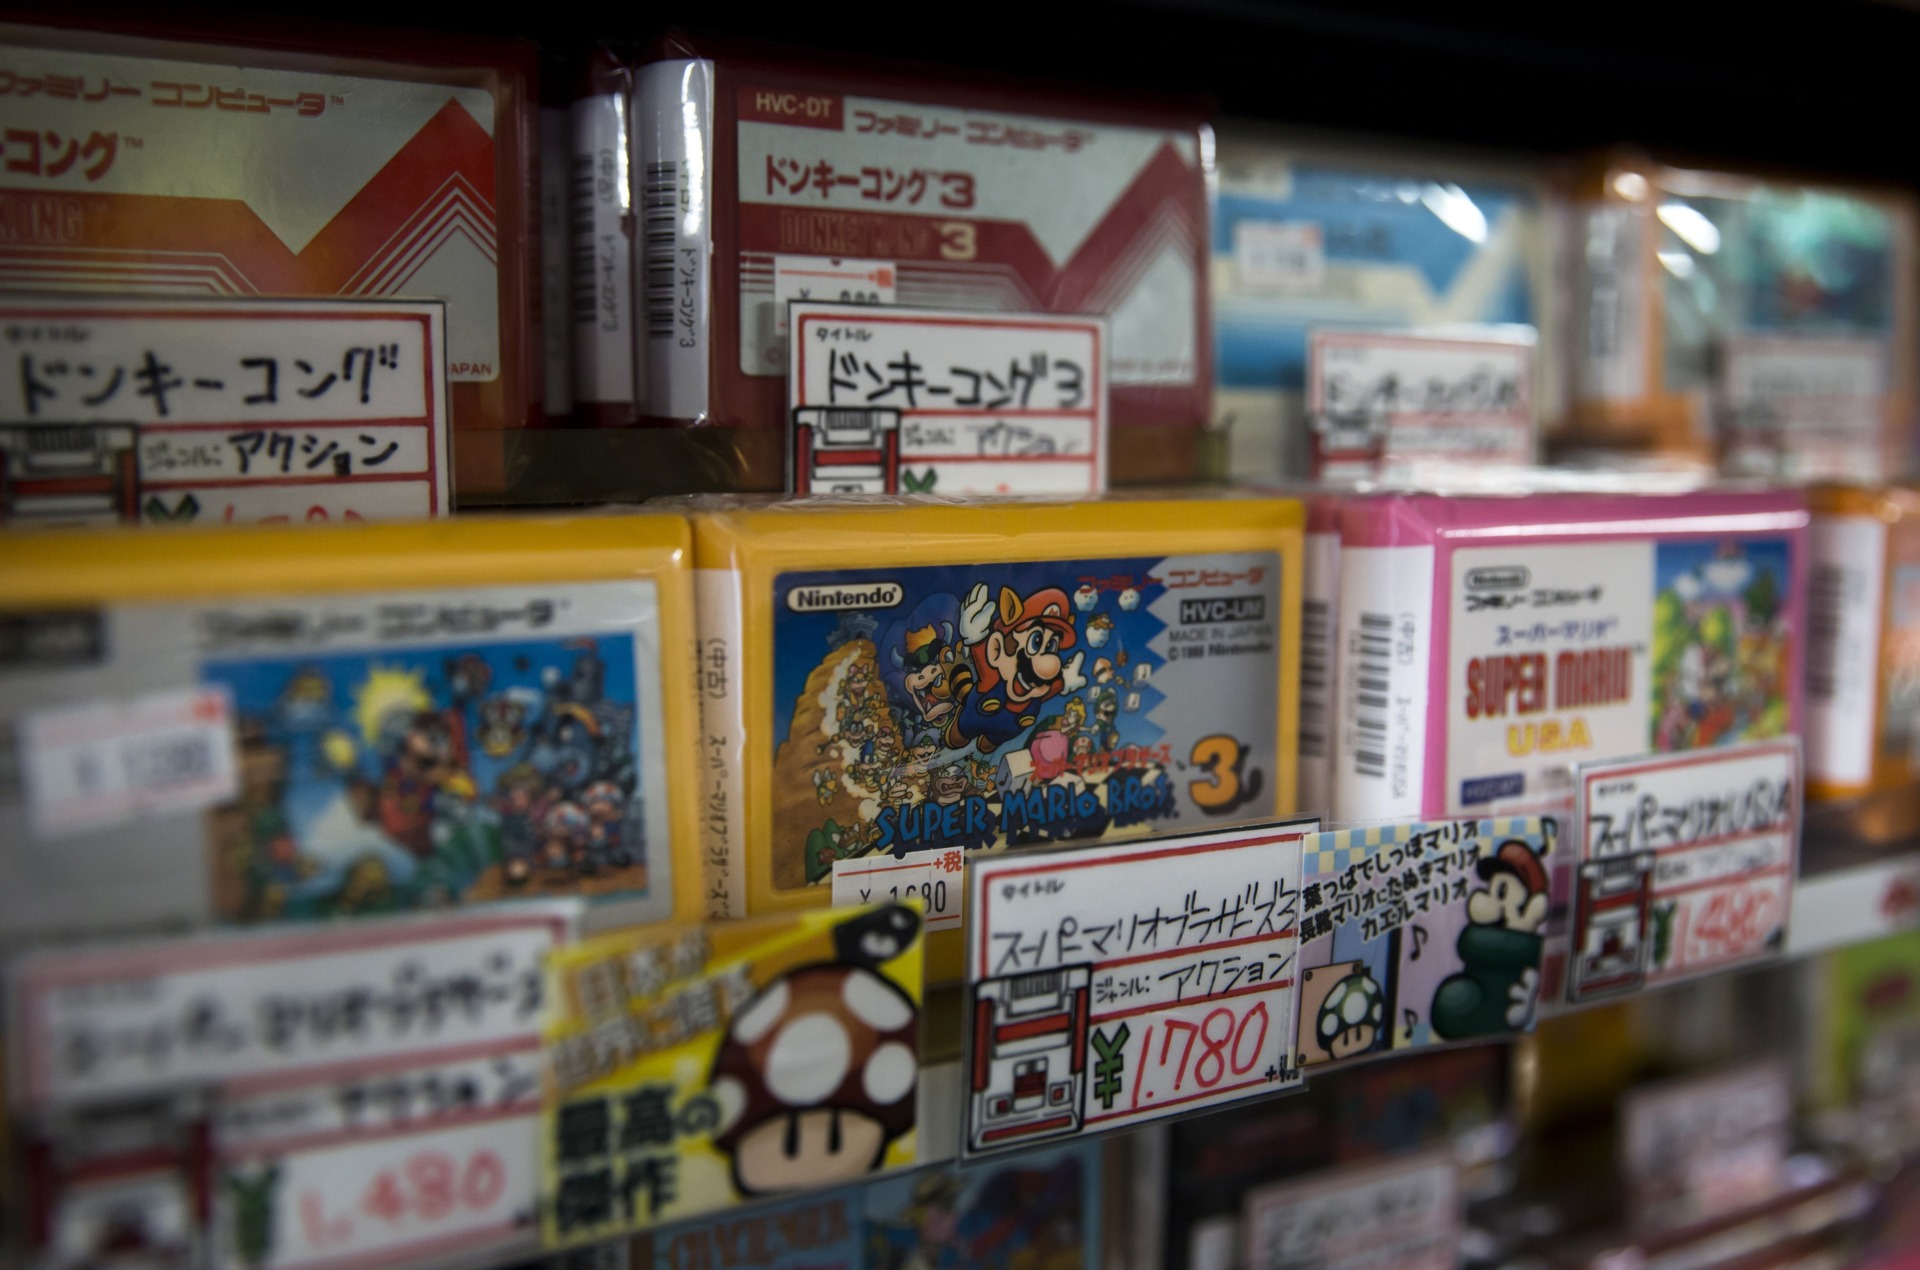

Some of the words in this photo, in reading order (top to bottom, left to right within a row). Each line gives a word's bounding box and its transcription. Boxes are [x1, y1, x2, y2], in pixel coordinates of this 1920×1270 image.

[151, 81, 326, 118] コンピュータ
[0, 128, 119, 182] コング
[815, 326, 874, 343] タイトル
[20, 342, 400, 418] ドンキーコング
[446, 361, 493, 377] APAN
[829, 348, 1086, 410] ドンキーコング3
[228, 430, 400, 478] アクション
[795, 586, 898, 608] Nintendo
[1466, 652, 1547, 720] SUPER
[1505, 716, 1594, 756] USA
[876, 796, 991, 851] SUPER
[1001, 784, 1097, 834] MARIO
[1001, 879, 1065, 902] タイトル
[1302, 819, 1480, 912] 葉っぱでしっぽマリオ
[1361, 876, 1470, 941] カエルマリオ
[1158, 951, 1297, 1003] アクション
